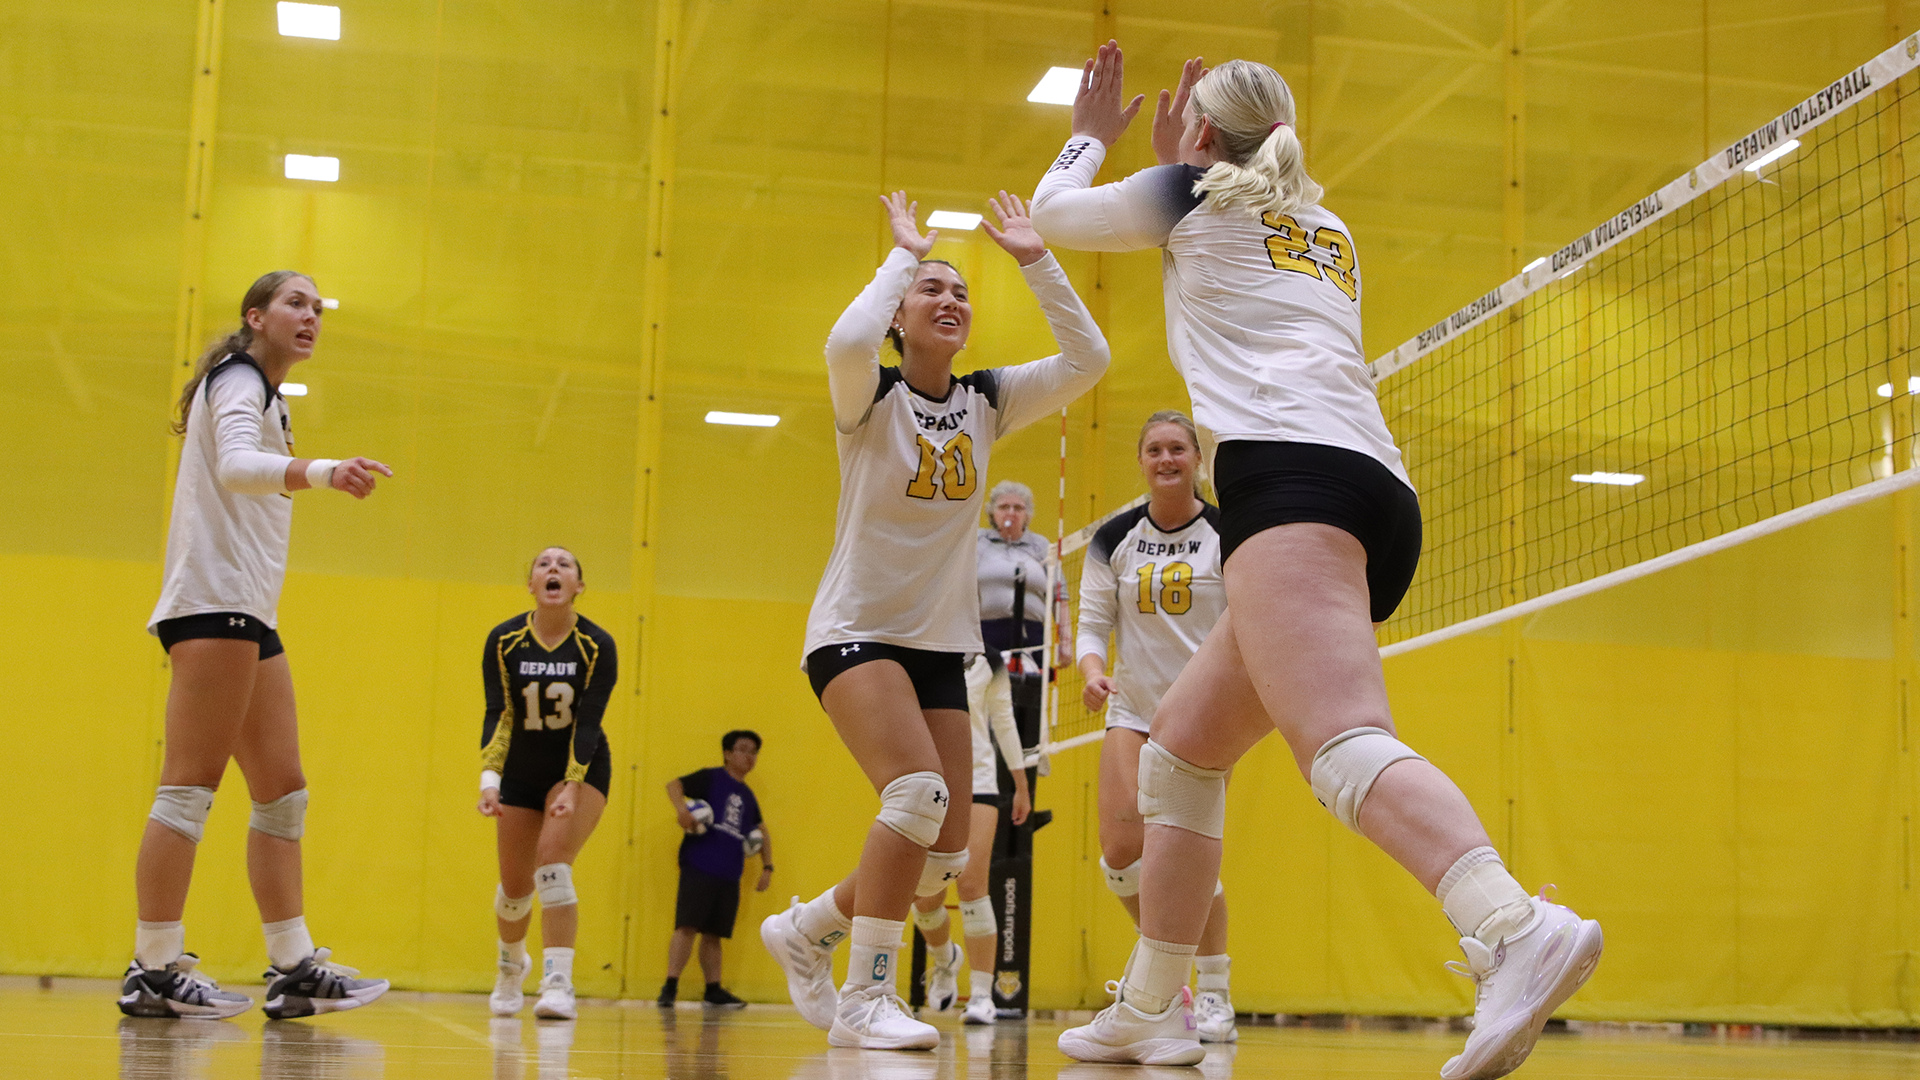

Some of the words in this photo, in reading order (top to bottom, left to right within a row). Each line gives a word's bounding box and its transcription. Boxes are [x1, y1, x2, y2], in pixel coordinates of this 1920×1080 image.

[1726, 120, 1778, 170] DEPAUW
[1782, 66, 1871, 135] VOLLEYBALL
[1261, 210, 1357, 302] 23
[1552, 233, 1593, 273] DEPAUW
[1595, 191, 1663, 247] VOLLEYBALL
[906, 429, 977, 501] 10
[1136, 539, 1202, 557] DEPAUW
[1136, 561, 1193, 615] 18
[519, 661, 578, 676] DEPAUW
[521, 681, 575, 731] 13
[1004, 877, 1017, 915] sports
[1002, 915, 1016, 963] imports
